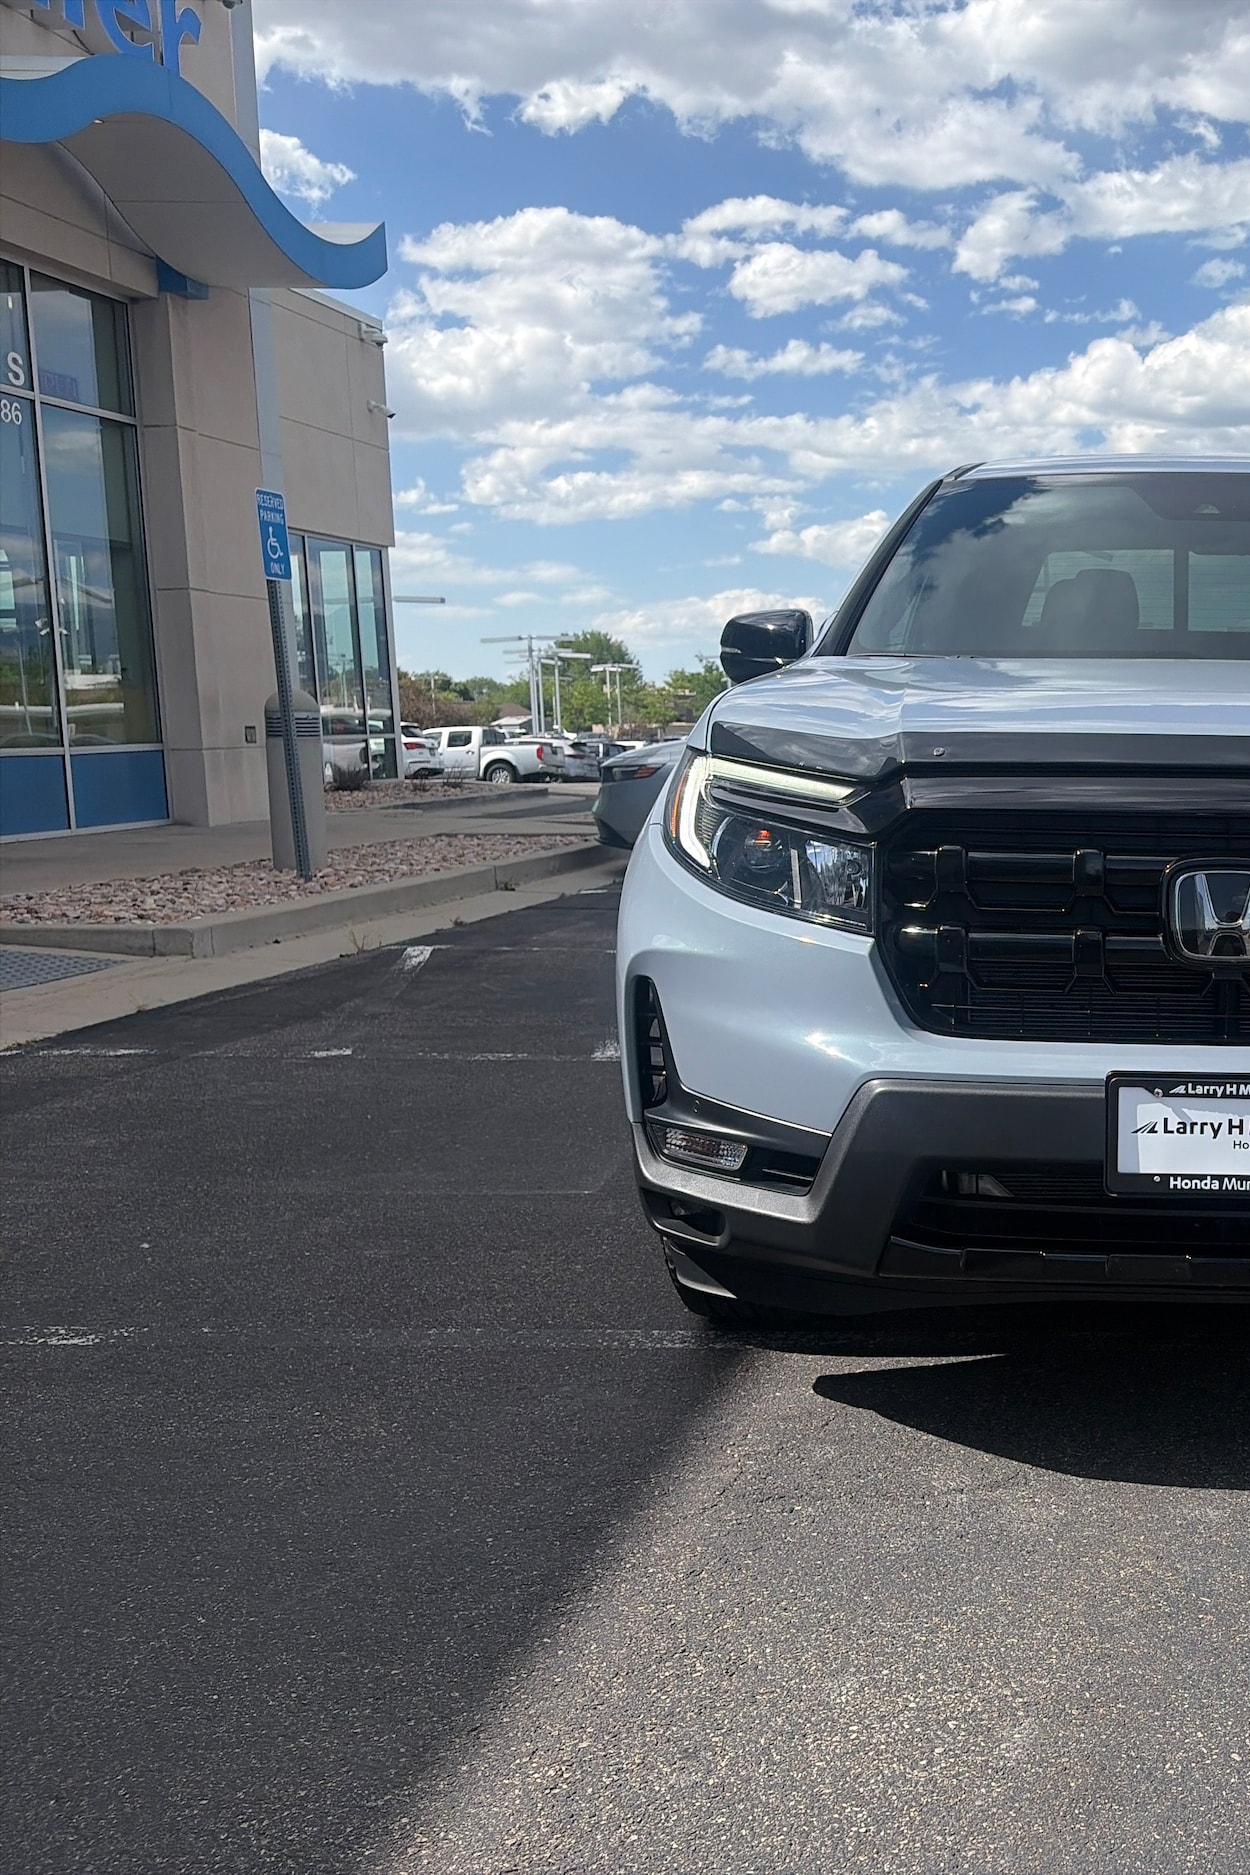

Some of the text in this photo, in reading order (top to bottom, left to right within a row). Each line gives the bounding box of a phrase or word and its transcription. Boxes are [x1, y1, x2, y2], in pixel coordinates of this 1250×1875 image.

[7, 351, 25, 386] S
[0, 398, 22, 425] 86
[256, 493, 284, 510] RESERVED
[260, 509, 284, 525] PARKING
[270, 561, 286, 576] ONLY
[1188, 1083, 1225, 1098] Larry
[1226, 1084, 1236, 1096] H
[1163, 1117, 1223, 1139] Larry
[1228, 1119, 1243, 1136] H
[1169, 1175, 1220, 1191] Honda
